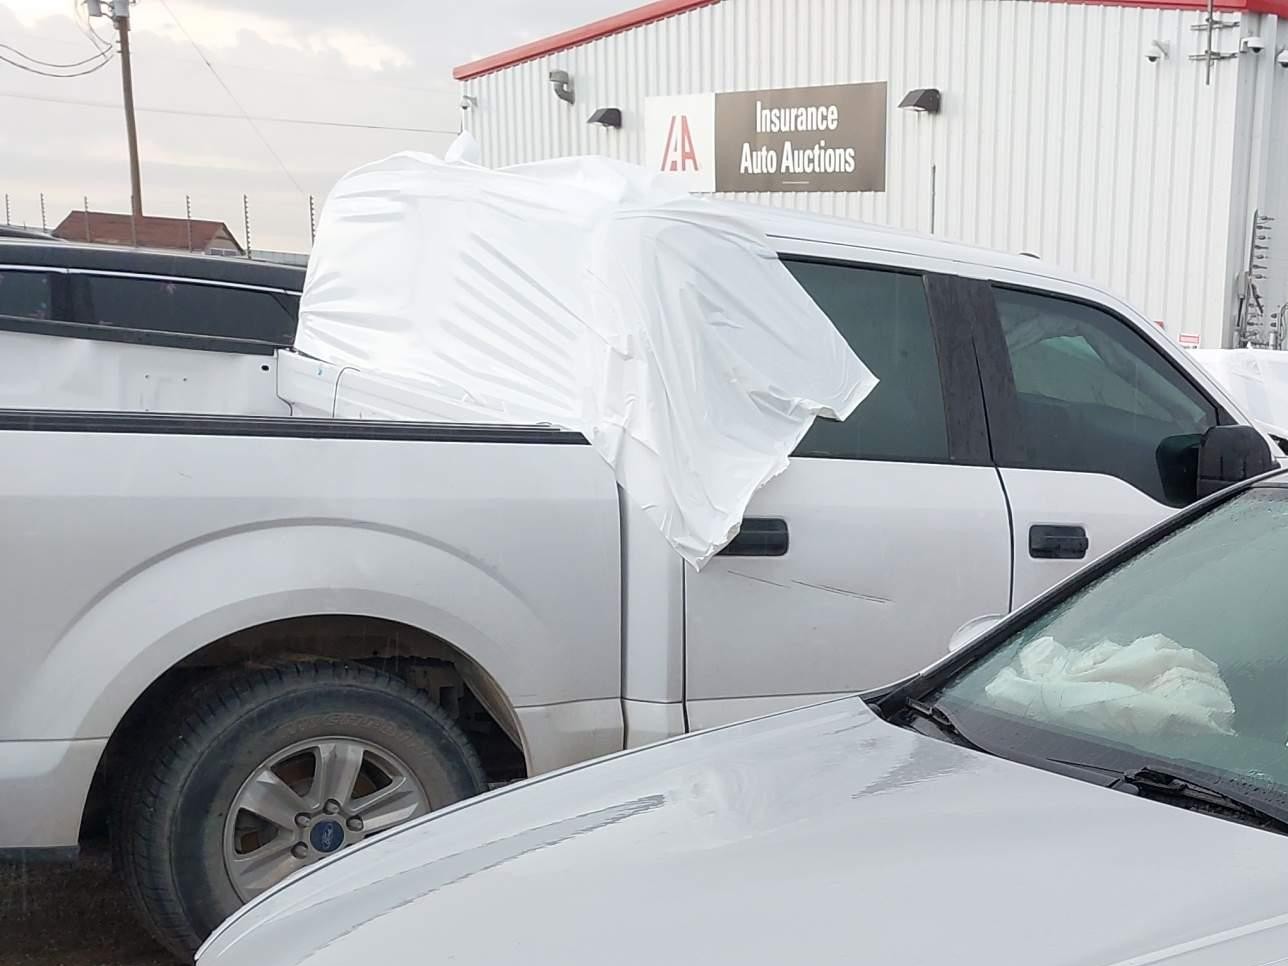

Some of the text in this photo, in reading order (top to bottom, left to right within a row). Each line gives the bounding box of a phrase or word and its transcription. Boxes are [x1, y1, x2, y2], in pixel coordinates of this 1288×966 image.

[755, 100, 839, 133] Insurance
[740, 139, 856, 174] Auto Auctions
